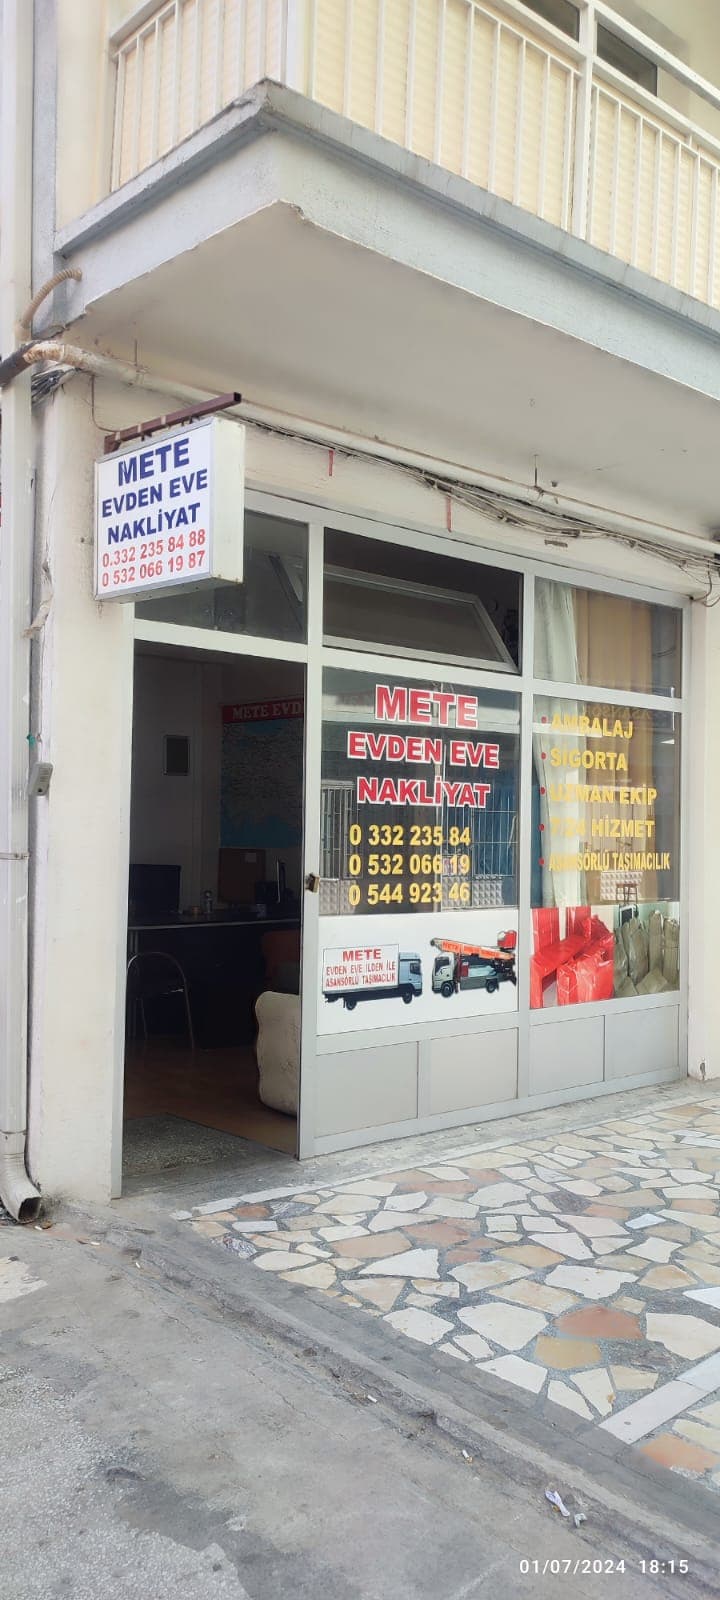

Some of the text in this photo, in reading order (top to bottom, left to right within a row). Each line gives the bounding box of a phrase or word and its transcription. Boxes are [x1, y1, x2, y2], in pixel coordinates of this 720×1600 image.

[118, 438, 190, 486] METE
[102, 469, 208, 518] EVDEN EVE
[108, 503, 200, 545] NAKLİYAT
[102, 528, 206, 568] 0.332 235 84 88
[102, 550, 206, 587] 0 532 066 19 87
[233, 704, 269, 721] METE
[375, 684, 478, 729] METE
[551, 713, 634, 740] AMBALAJ
[347, 731, 500, 769] EVDEN EVE
[357, 776, 491, 808] NAKLİYAT
[550, 784, 658, 806] UZMAN EKİP
[349, 824, 471, 846] 0 332 235 84
[591, 815, 656, 838] HİZMET
[349, 854, 470, 875] 0 532 066 19
[349, 882, 470, 905] 0 544 923 46
[342, 949, 381, 962] METE
[326, 965, 347, 976] EVDEN
[351, 963, 363, 974] EVE
